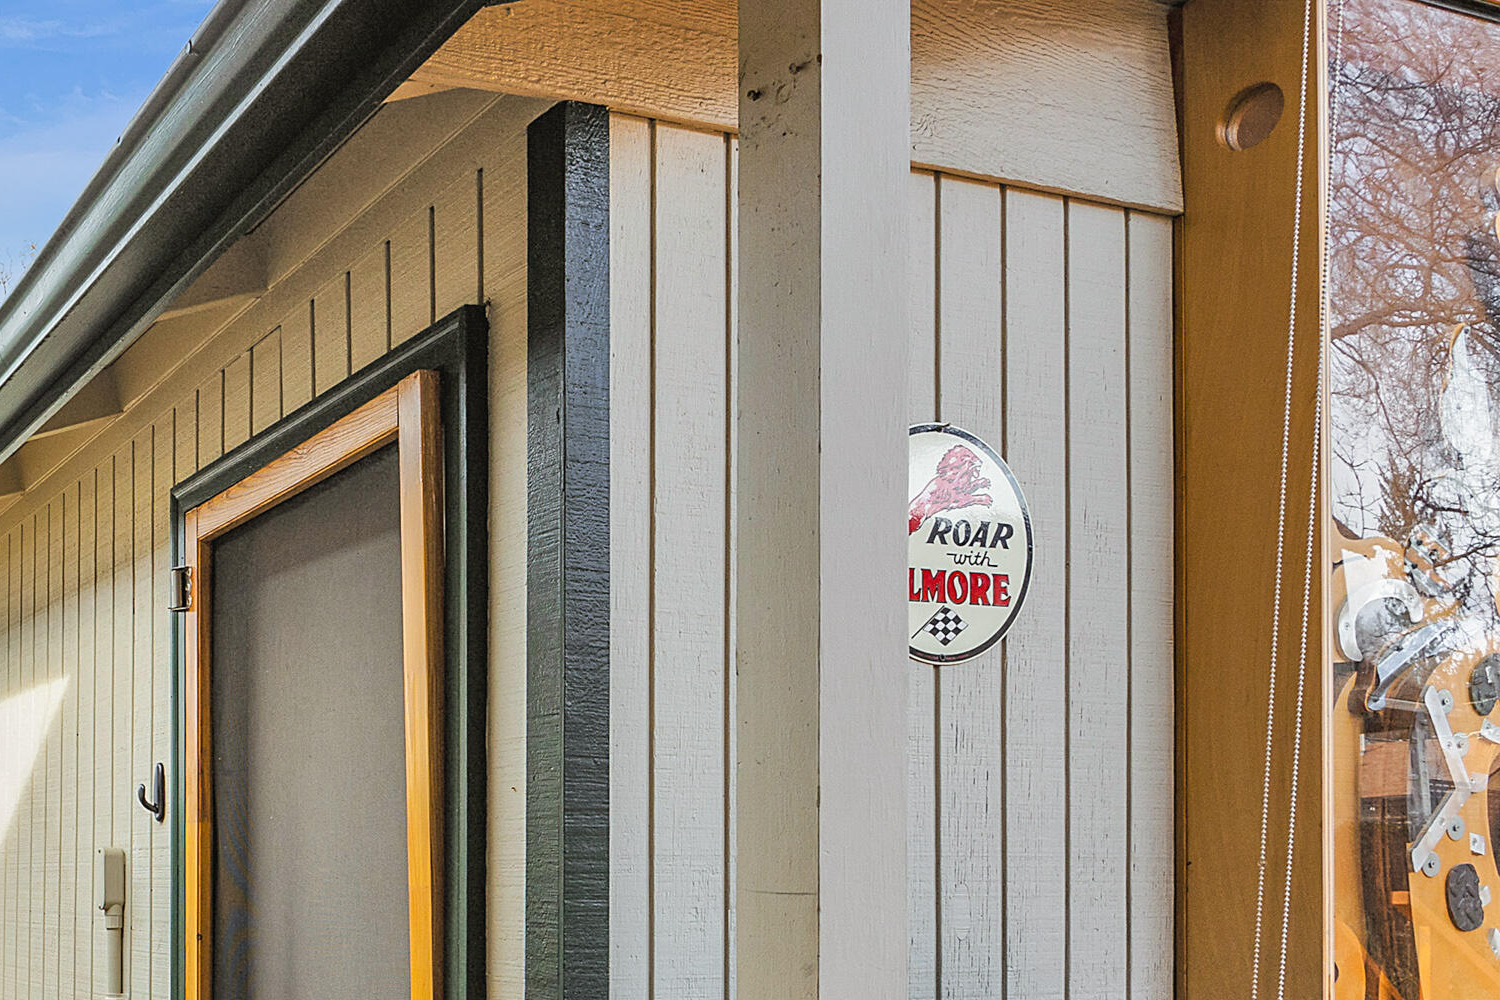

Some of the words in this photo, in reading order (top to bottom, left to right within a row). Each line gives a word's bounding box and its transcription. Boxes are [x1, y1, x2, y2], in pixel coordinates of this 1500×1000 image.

[926, 516, 1014, 550] ROAR
[946, 551, 998, 568] with
[908, 567, 1012, 608] LMORE
